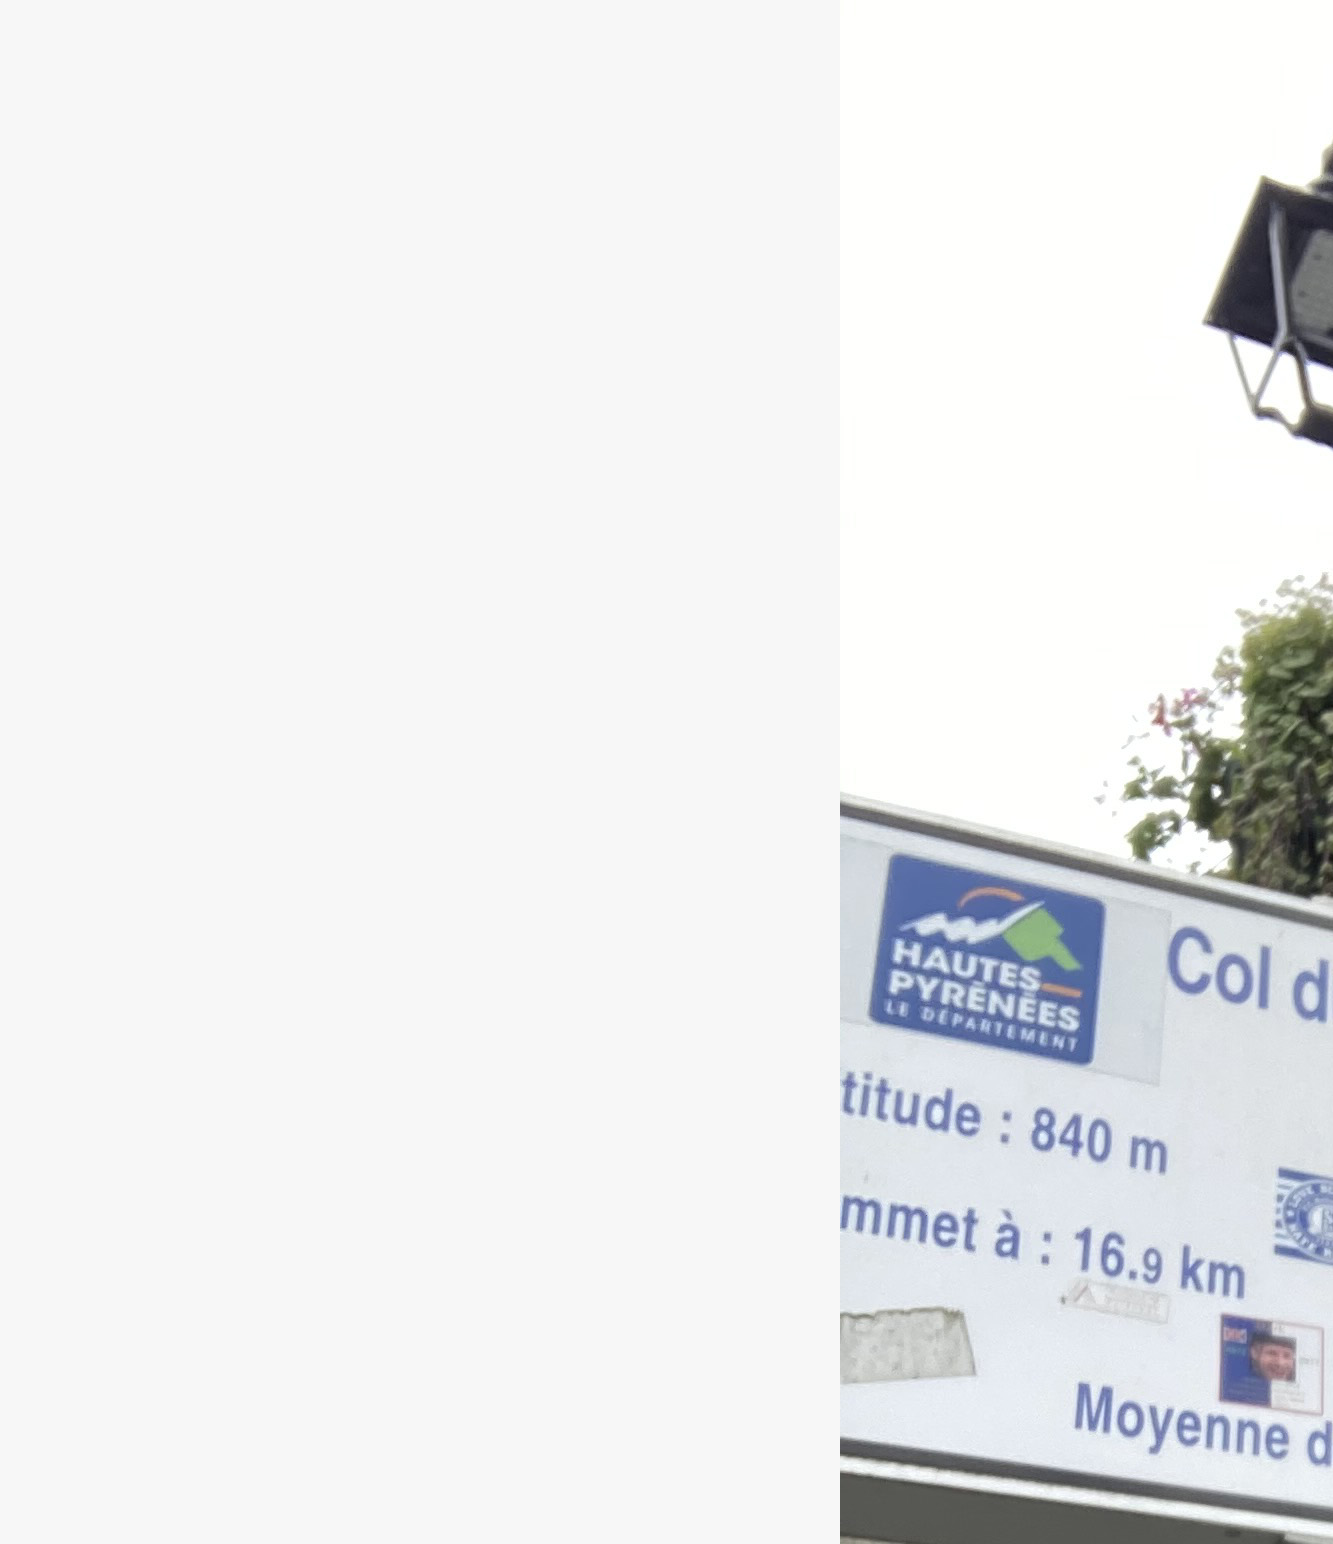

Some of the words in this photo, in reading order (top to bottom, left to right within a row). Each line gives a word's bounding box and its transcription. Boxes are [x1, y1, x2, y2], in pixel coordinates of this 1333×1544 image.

[888, 968, 1081, 1033] PYRÉNÉES
[891, 937, 1042, 993] HAUTES
[1166, 926, 1272, 1009] Col
[883, 999, 910, 1018] LE
[925, 1005, 1081, 1053] DÉPARTEMENT
[841, 1070, 983, 1138] titude
[1030, 1106, 1113, 1164] 840
[1129, 1135, 1169, 1175] m
[993, 1209, 1022, 1261] à
[1074, 1226, 1164, 1286] 16.9
[1180, 1245, 1247, 1300] km
[1074, 1381, 1290, 1461] Moyenne
